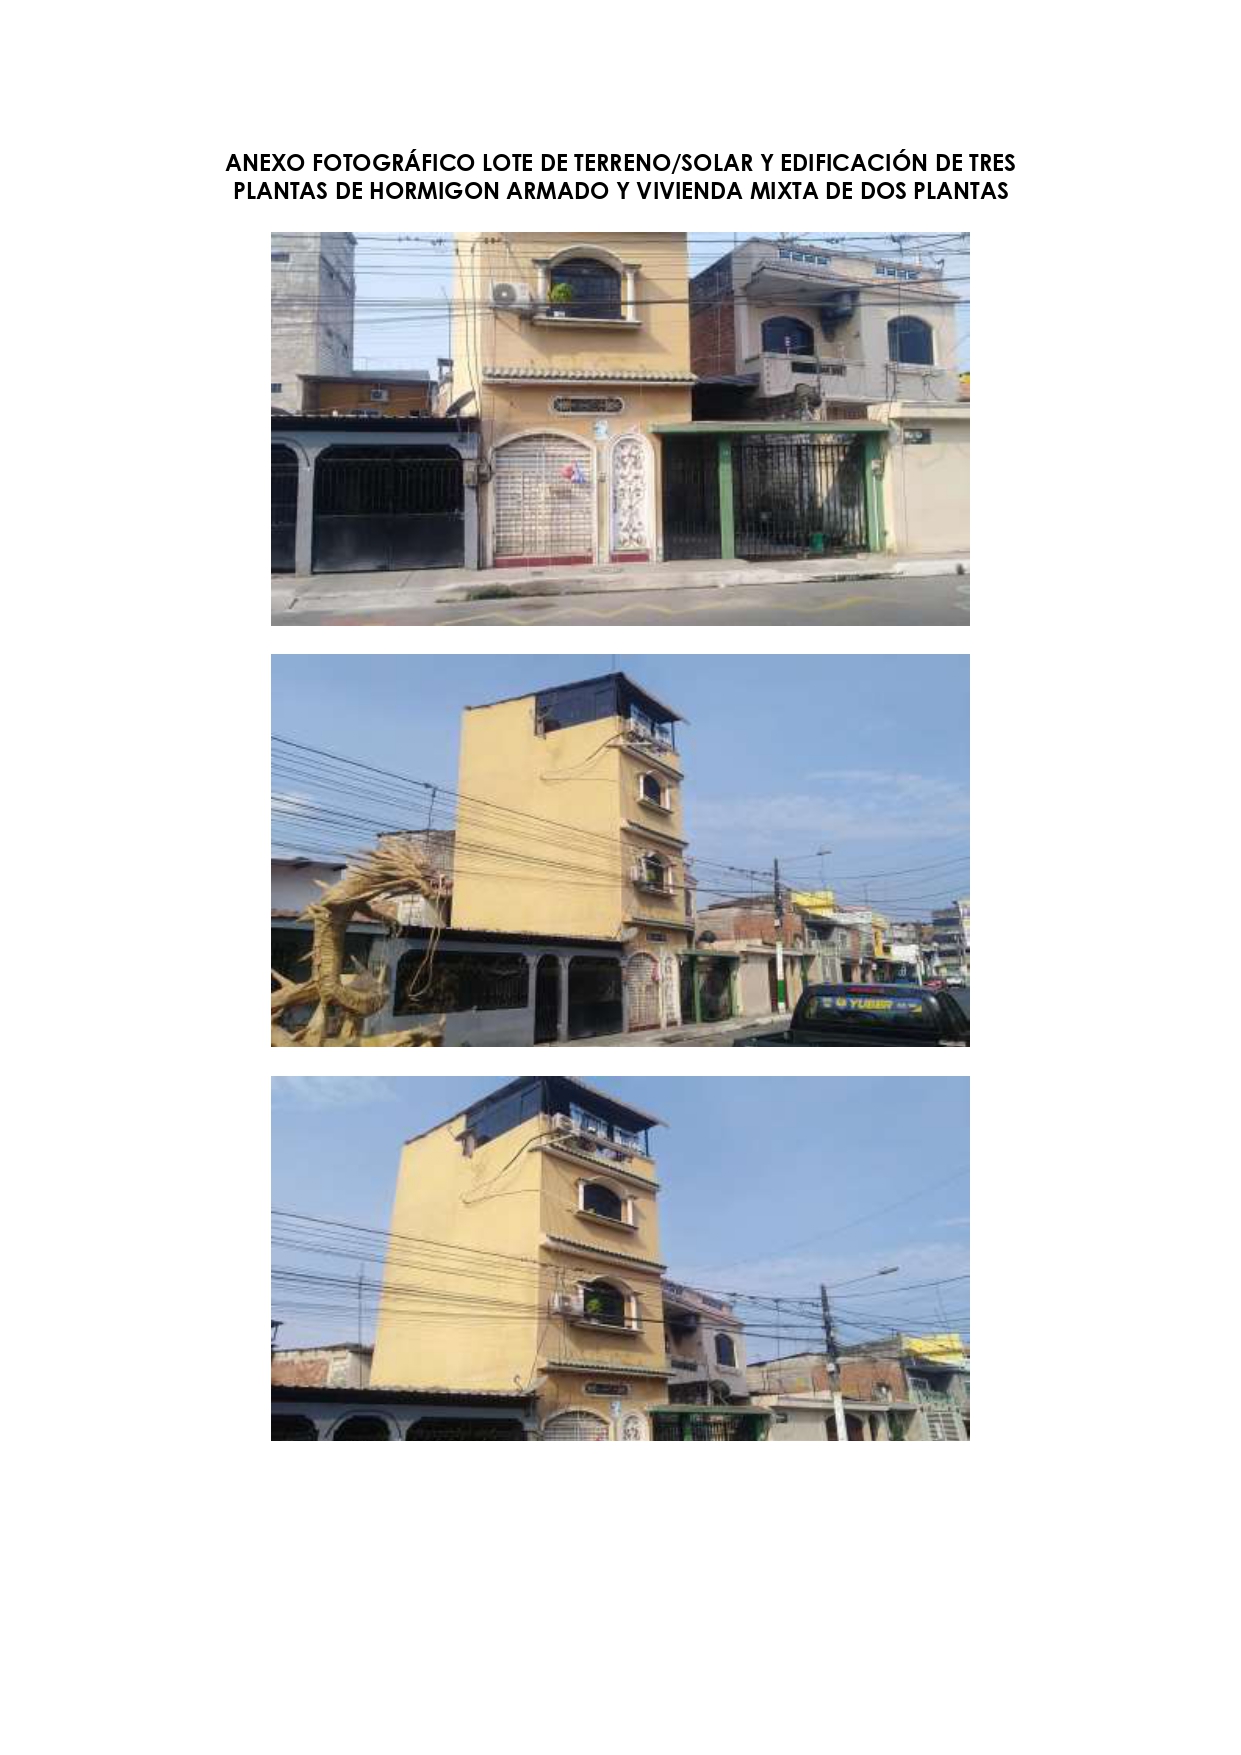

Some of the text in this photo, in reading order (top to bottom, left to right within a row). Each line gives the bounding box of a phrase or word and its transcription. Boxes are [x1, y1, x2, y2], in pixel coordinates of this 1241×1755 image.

[225, 148, 1016, 175] ANEXO FOTOGRÁFICO LOTE DE TERRENO/SOLAR Y EDIFICACIÓN DE TRES
[234, 181, 1009, 200] PLANTAS DE HORMIGON ARMADO Y VIVIENDA MIXTA DE DOS PLANTAS
